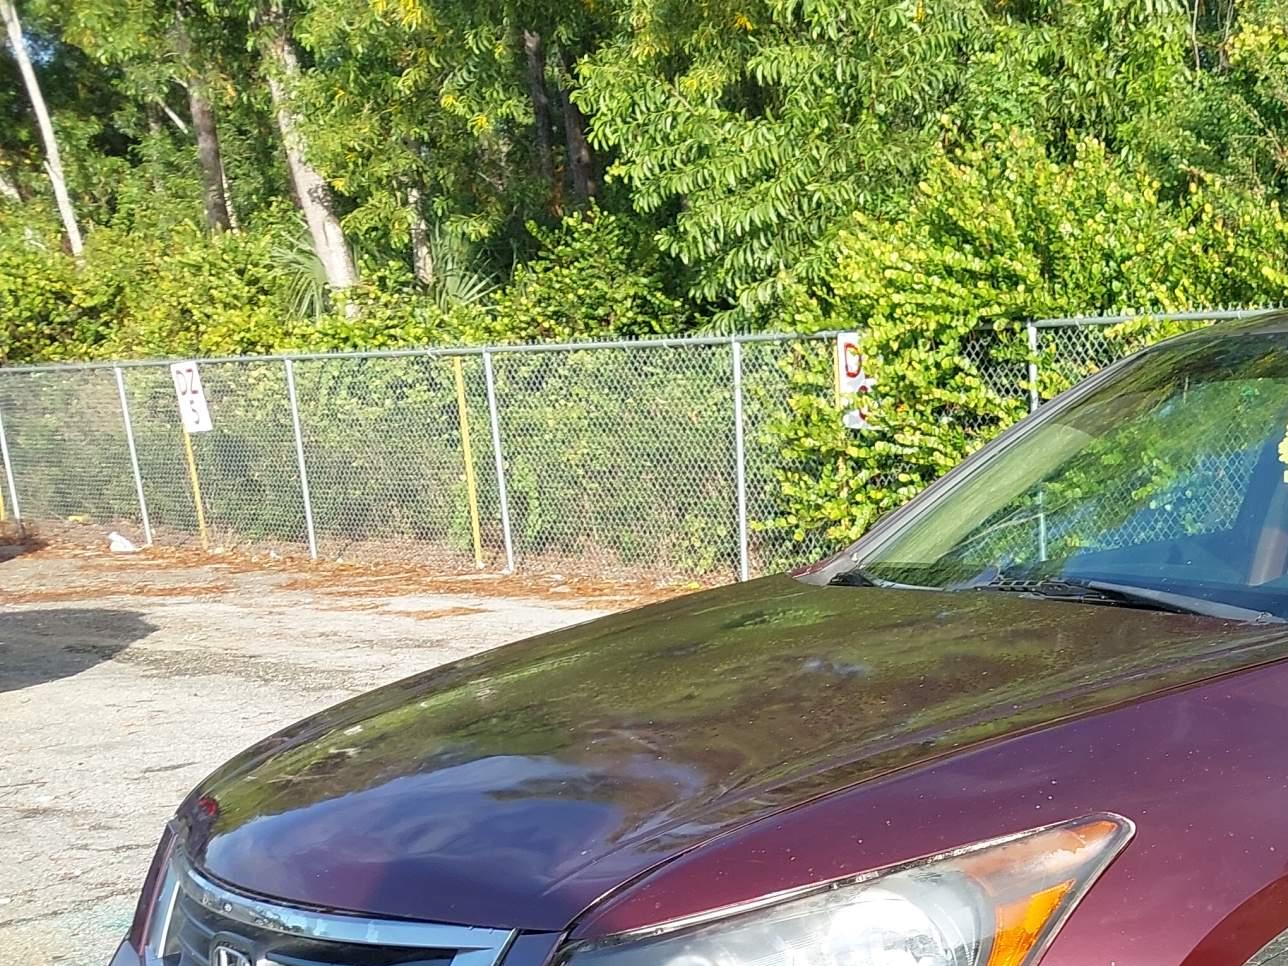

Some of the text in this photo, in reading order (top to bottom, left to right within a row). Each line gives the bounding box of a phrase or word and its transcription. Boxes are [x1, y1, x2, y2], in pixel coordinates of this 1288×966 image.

[844, 342, 862, 378] D
[175, 368, 199, 396] DZ
[189, 399, 201, 425] 5
